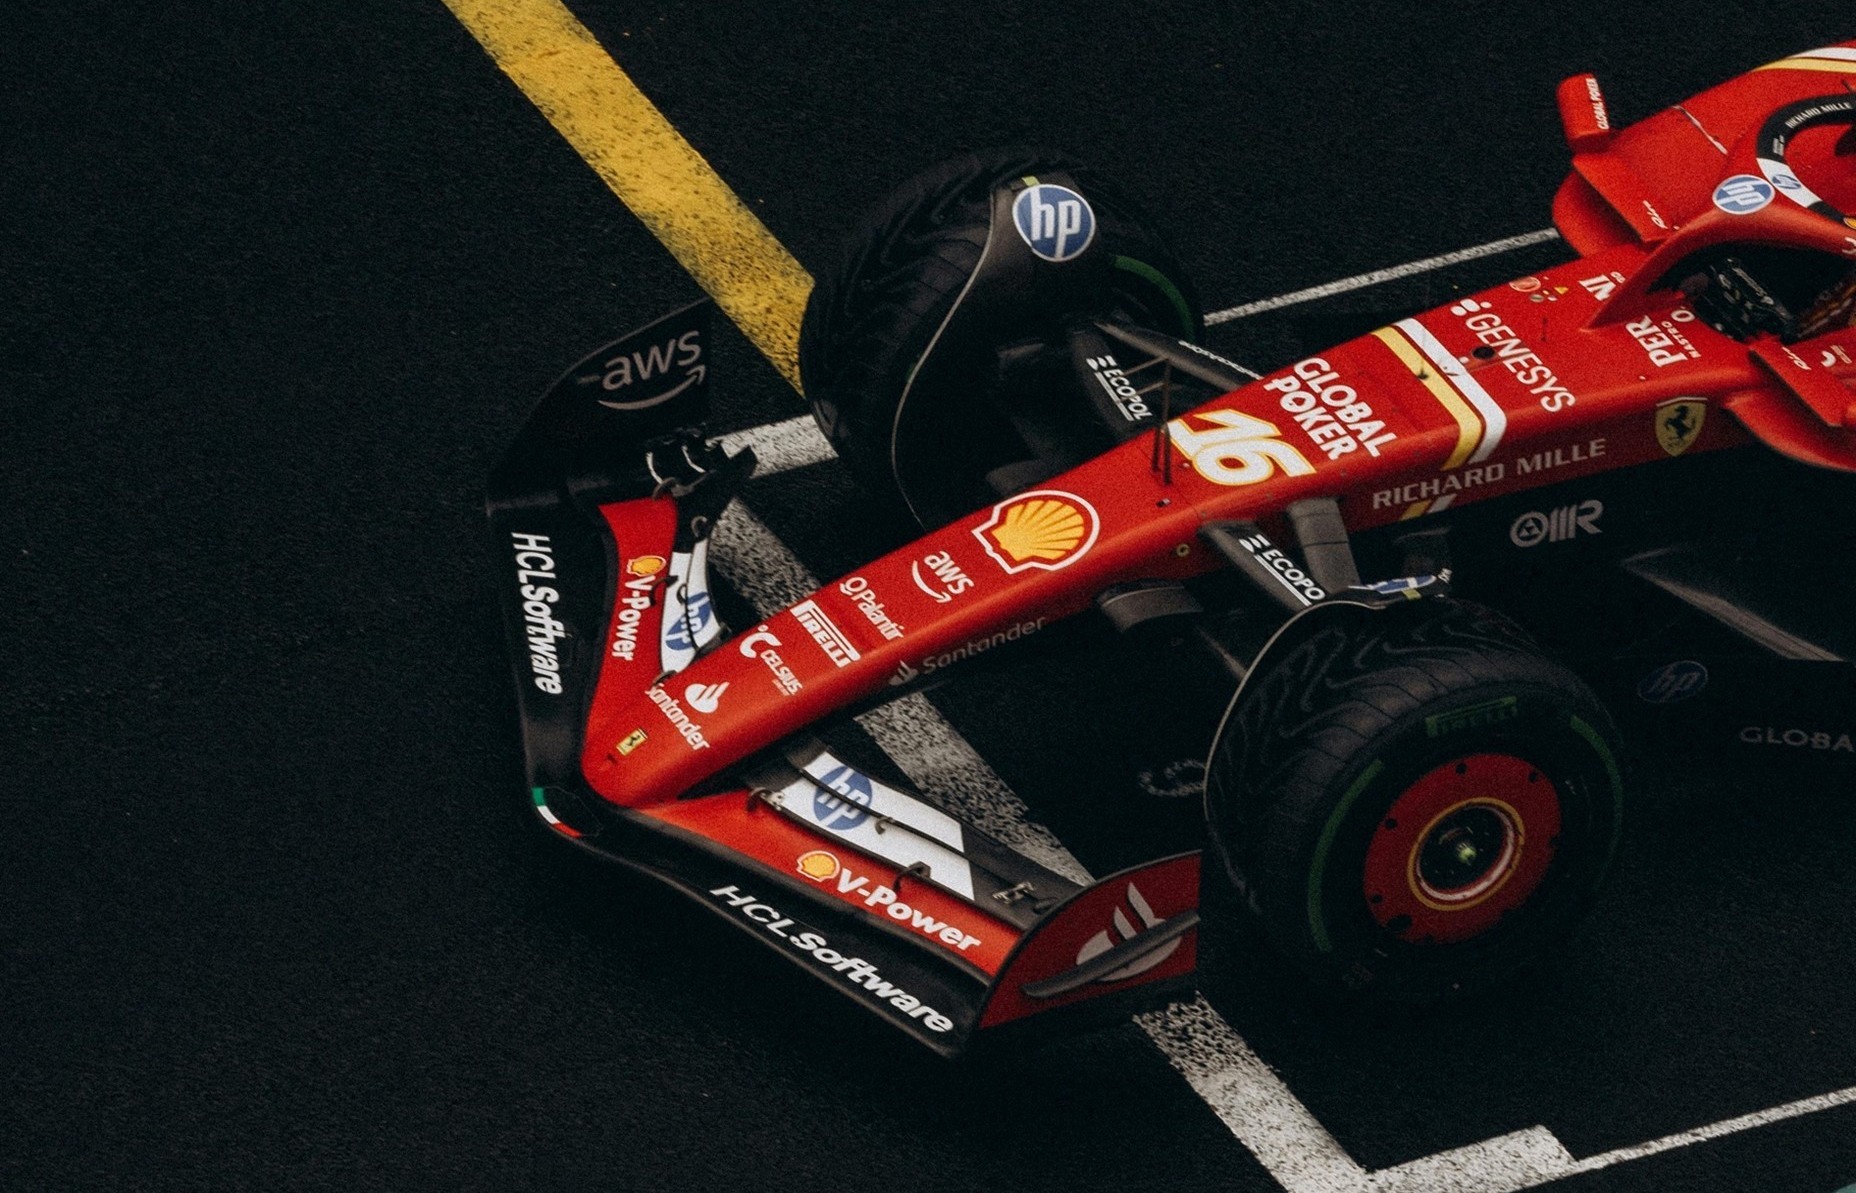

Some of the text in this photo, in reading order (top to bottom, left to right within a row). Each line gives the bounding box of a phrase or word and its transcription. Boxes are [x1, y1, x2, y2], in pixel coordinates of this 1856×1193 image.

[1030, 186, 1082, 260] hp
[601, 330, 702, 391] aws
[1104, 367, 1153, 421] ECOPOL
[1466, 313, 1577, 413] GENESYS
[1263, 374, 1358, 461] POKER
[1293, 357, 1398, 458] GLOBAL
[1166, 409, 1317, 486] 16
[1372, 438, 1608, 509] RICHARD MILLE
[924, 550, 975, 596] aws
[1262, 546, 1327, 601] ECOPO
[511, 531, 564, 696] HCLSoftware
[611, 574, 655, 661] V-Power
[790, 599, 862, 669] PIRELLI
[855, 586, 905, 642] Palantir
[922, 615, 1048, 676] Santander
[760, 650, 803, 695] CELSIUS
[1740, 726, 1855, 753] GLOBA
[815, 766, 872, 829] hp
[836, 869, 983, 953] V-Power
[709, 883, 956, 1034] HCLSoftware
